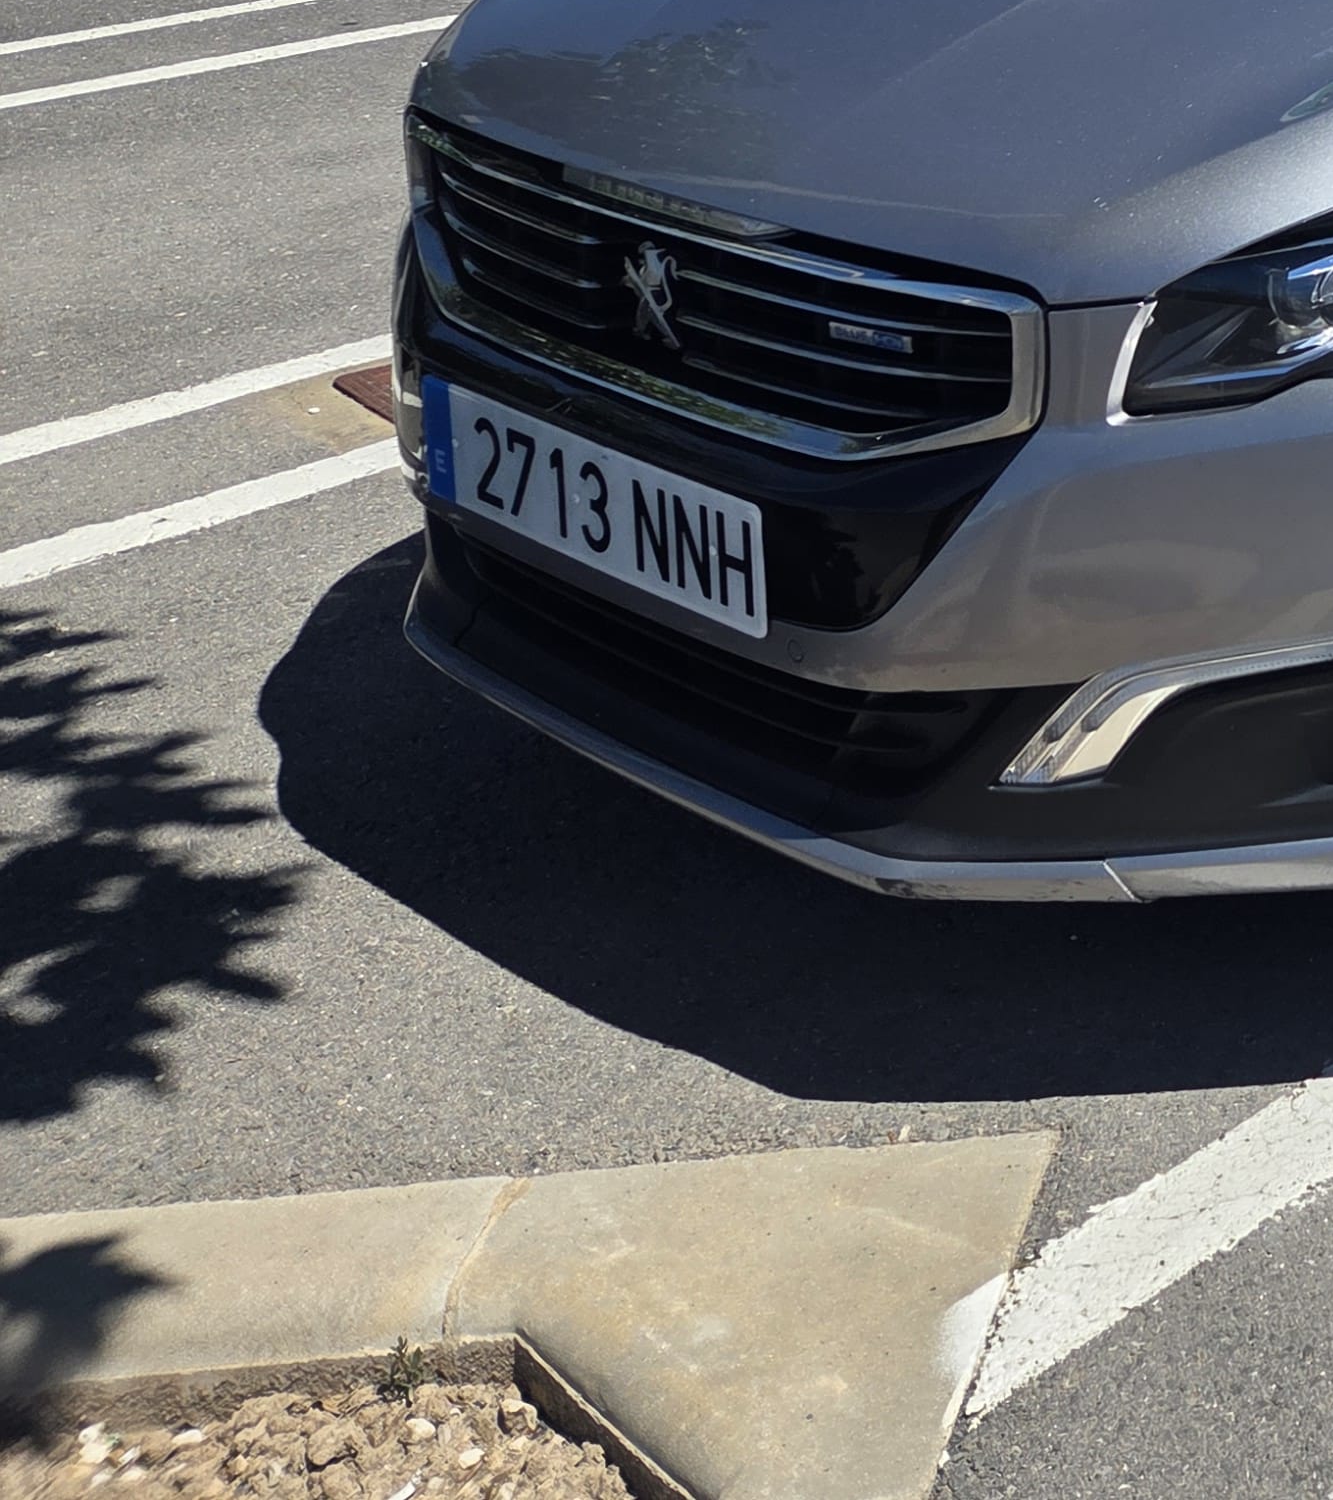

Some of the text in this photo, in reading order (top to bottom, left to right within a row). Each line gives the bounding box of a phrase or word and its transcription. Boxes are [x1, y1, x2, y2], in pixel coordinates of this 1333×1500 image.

[435, 448, 448, 474] E
[474, 416, 757, 618] 2713 NNH
